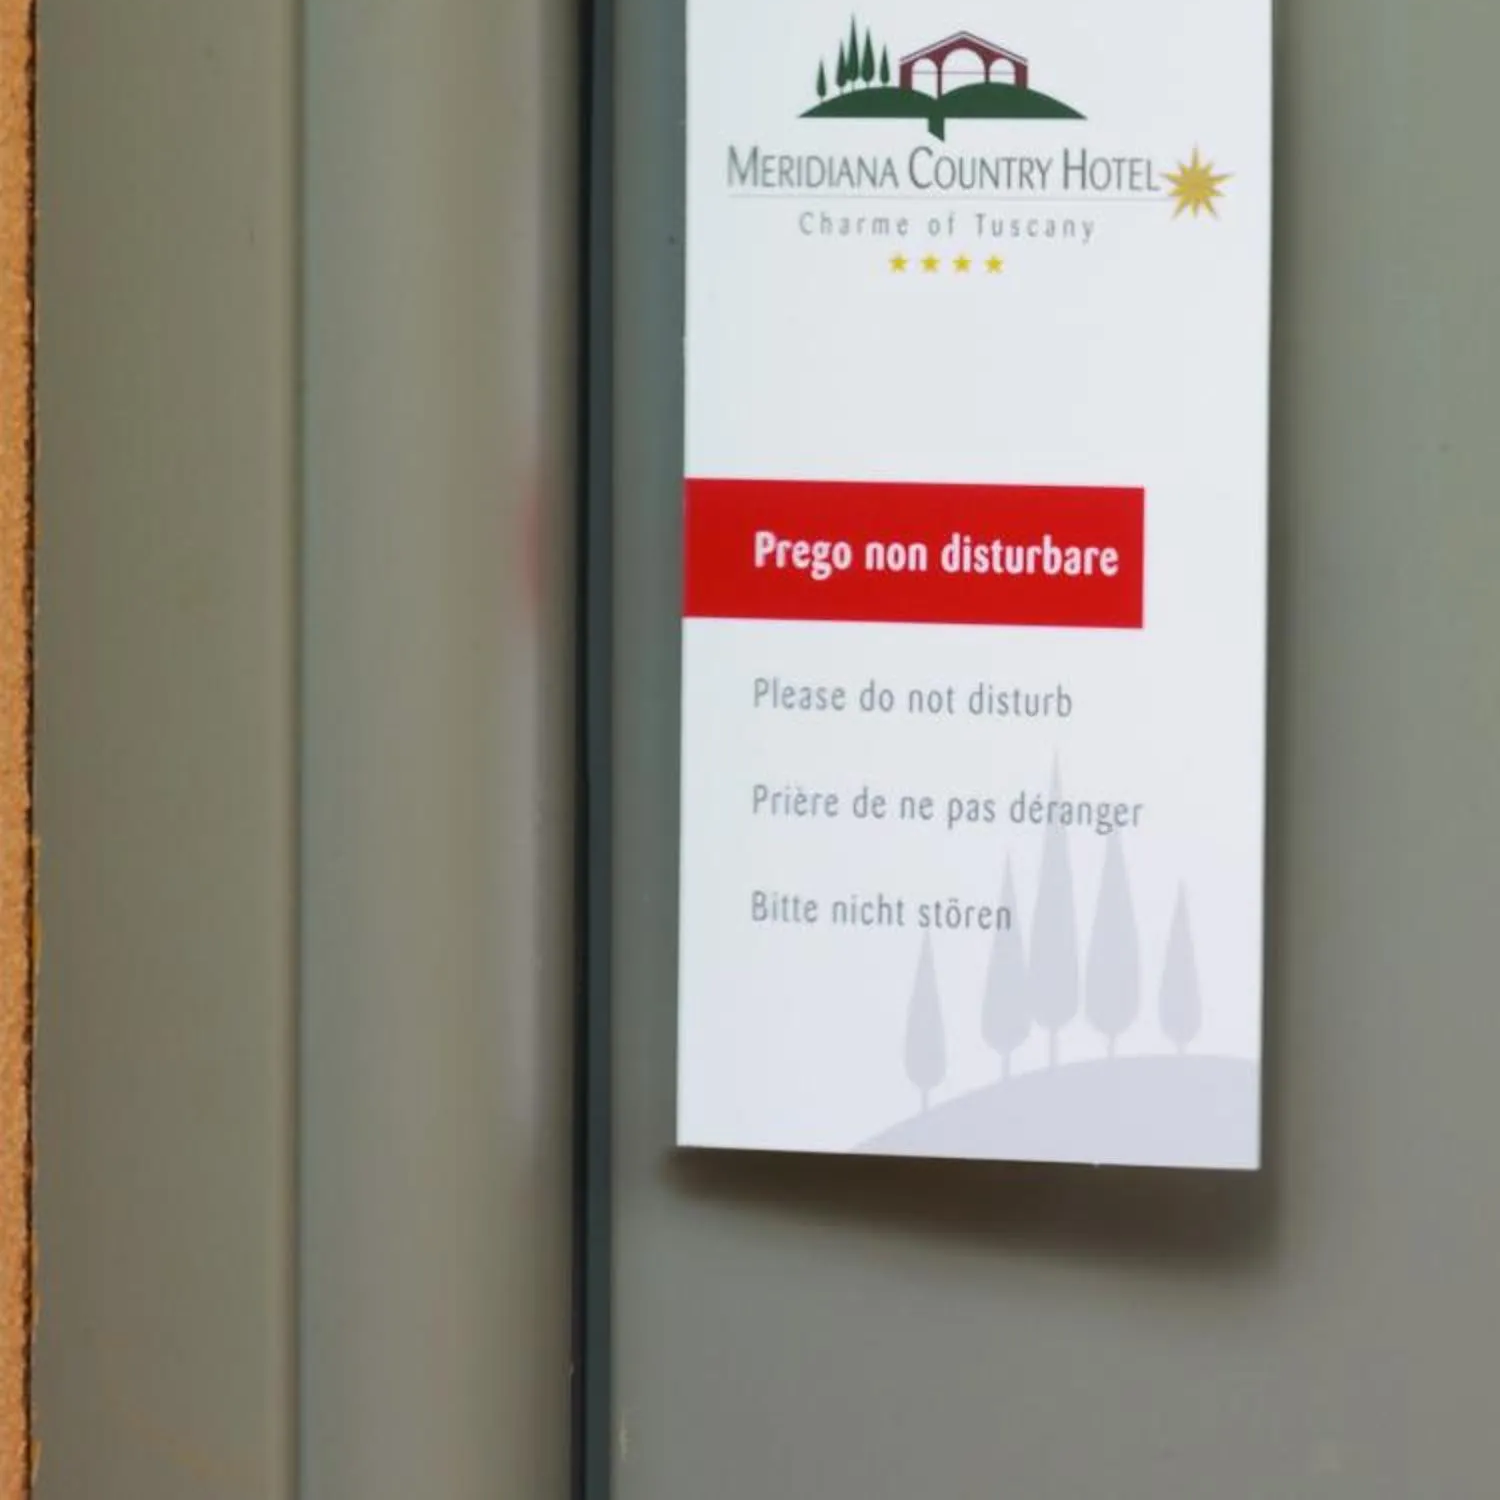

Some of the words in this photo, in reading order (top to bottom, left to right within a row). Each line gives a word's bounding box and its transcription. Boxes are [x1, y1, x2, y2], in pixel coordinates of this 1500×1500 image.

[1063, 148, 1160, 192] HOTEL
[799, 211, 909, 236] Charme
[928, 213, 955, 237] of
[976, 213, 1095, 242] Tuscany
[753, 531, 851, 580] Prego
[865, 542, 927, 572] non
[941, 533, 1118, 576] disturbare
[753, 677, 846, 711] Please
[859, 679, 894, 714] do
[907, 684, 955, 715] not
[968, 682, 1073, 718] disturb
[752, 784, 838, 817] Prière
[852, 786, 886, 819] de
[899, 794, 933, 821] ne
[947, 796, 995, 829] pas
[1009, 791, 1142, 835] déranger
[751, 890, 818, 923] Bitte
[832, 893, 905, 927] nicht
[917, 898, 1011, 930] stören
